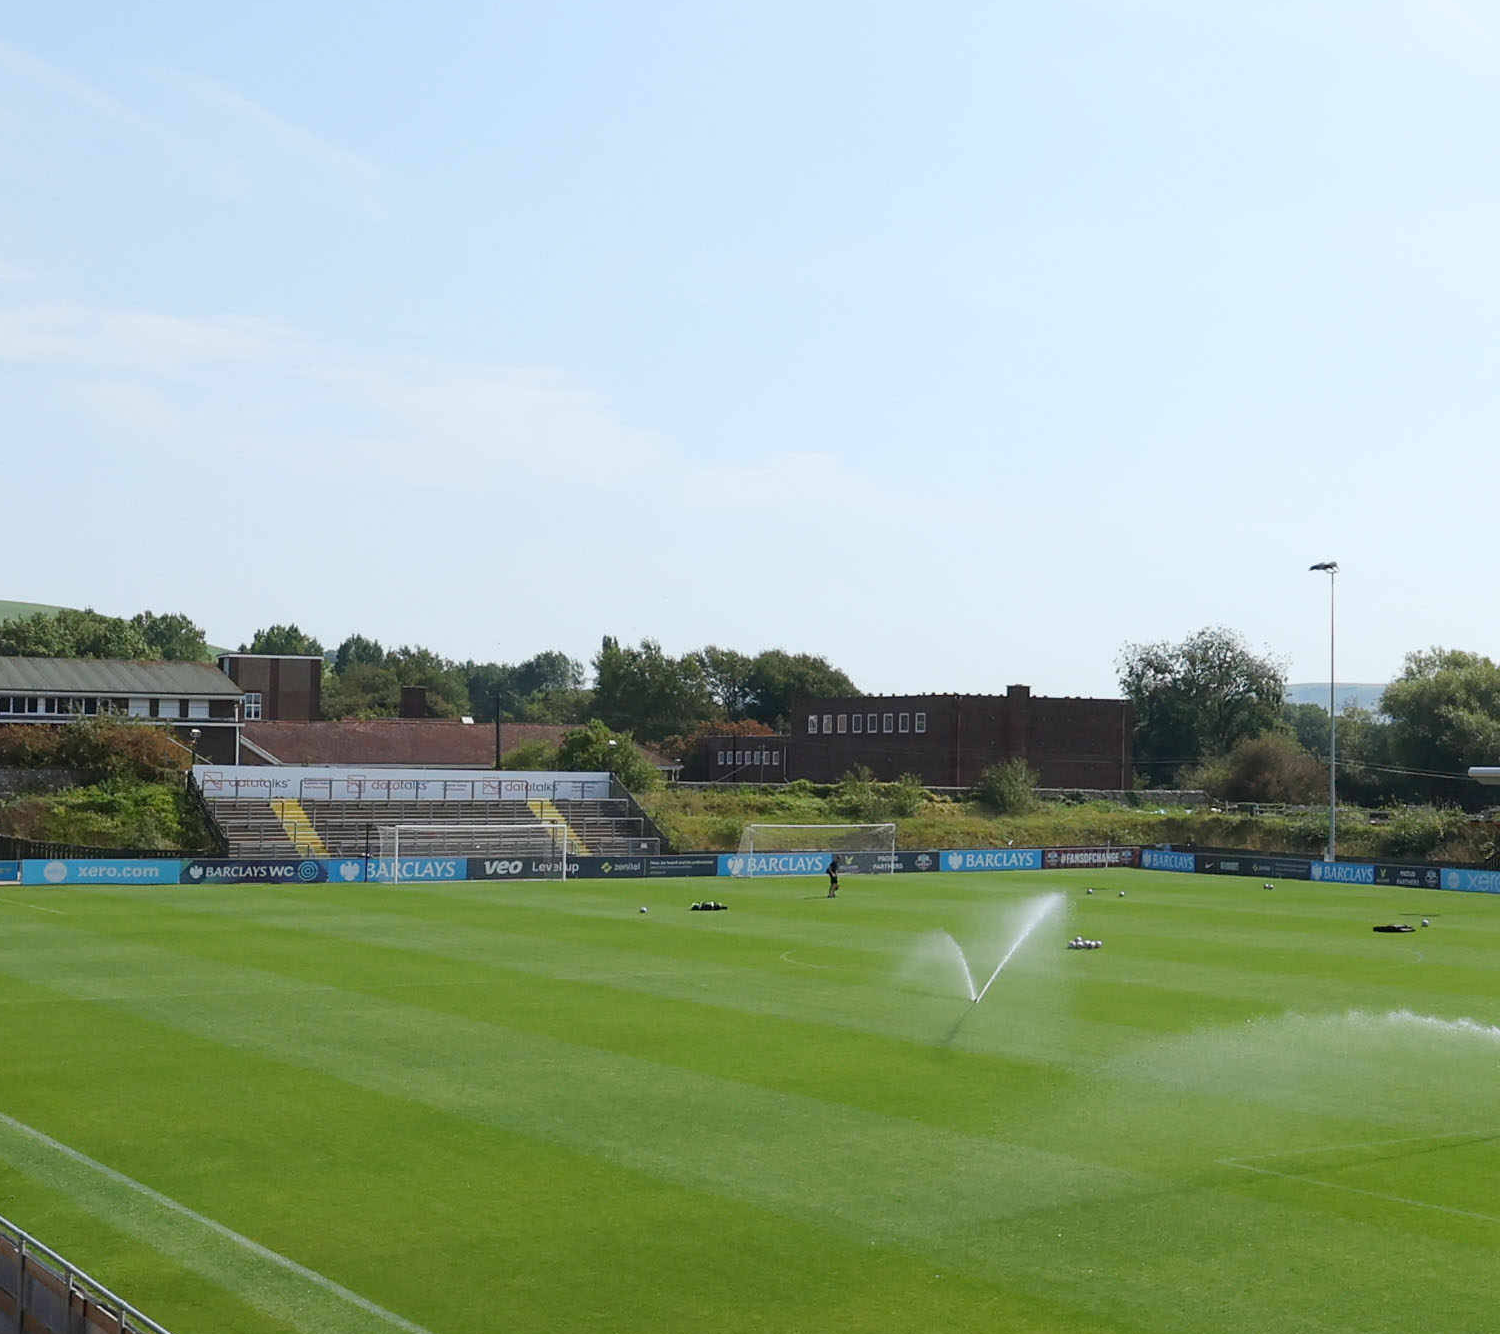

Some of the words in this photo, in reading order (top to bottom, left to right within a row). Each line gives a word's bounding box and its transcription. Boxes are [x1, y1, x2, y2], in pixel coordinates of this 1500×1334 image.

[748, 855, 823, 872] BARCLAYS
[966, 852, 1034, 868] BARCLAYS
[1151, 852, 1195, 870] BARCLAYS
[78, 863, 159, 878] xero.com
[205, 866, 268, 877] BARCLAYS
[269, 866, 294, 877] WC
[367, 860, 456, 878] BARCLAYS
[1324, 864, 1374, 883] BARCLAYS
